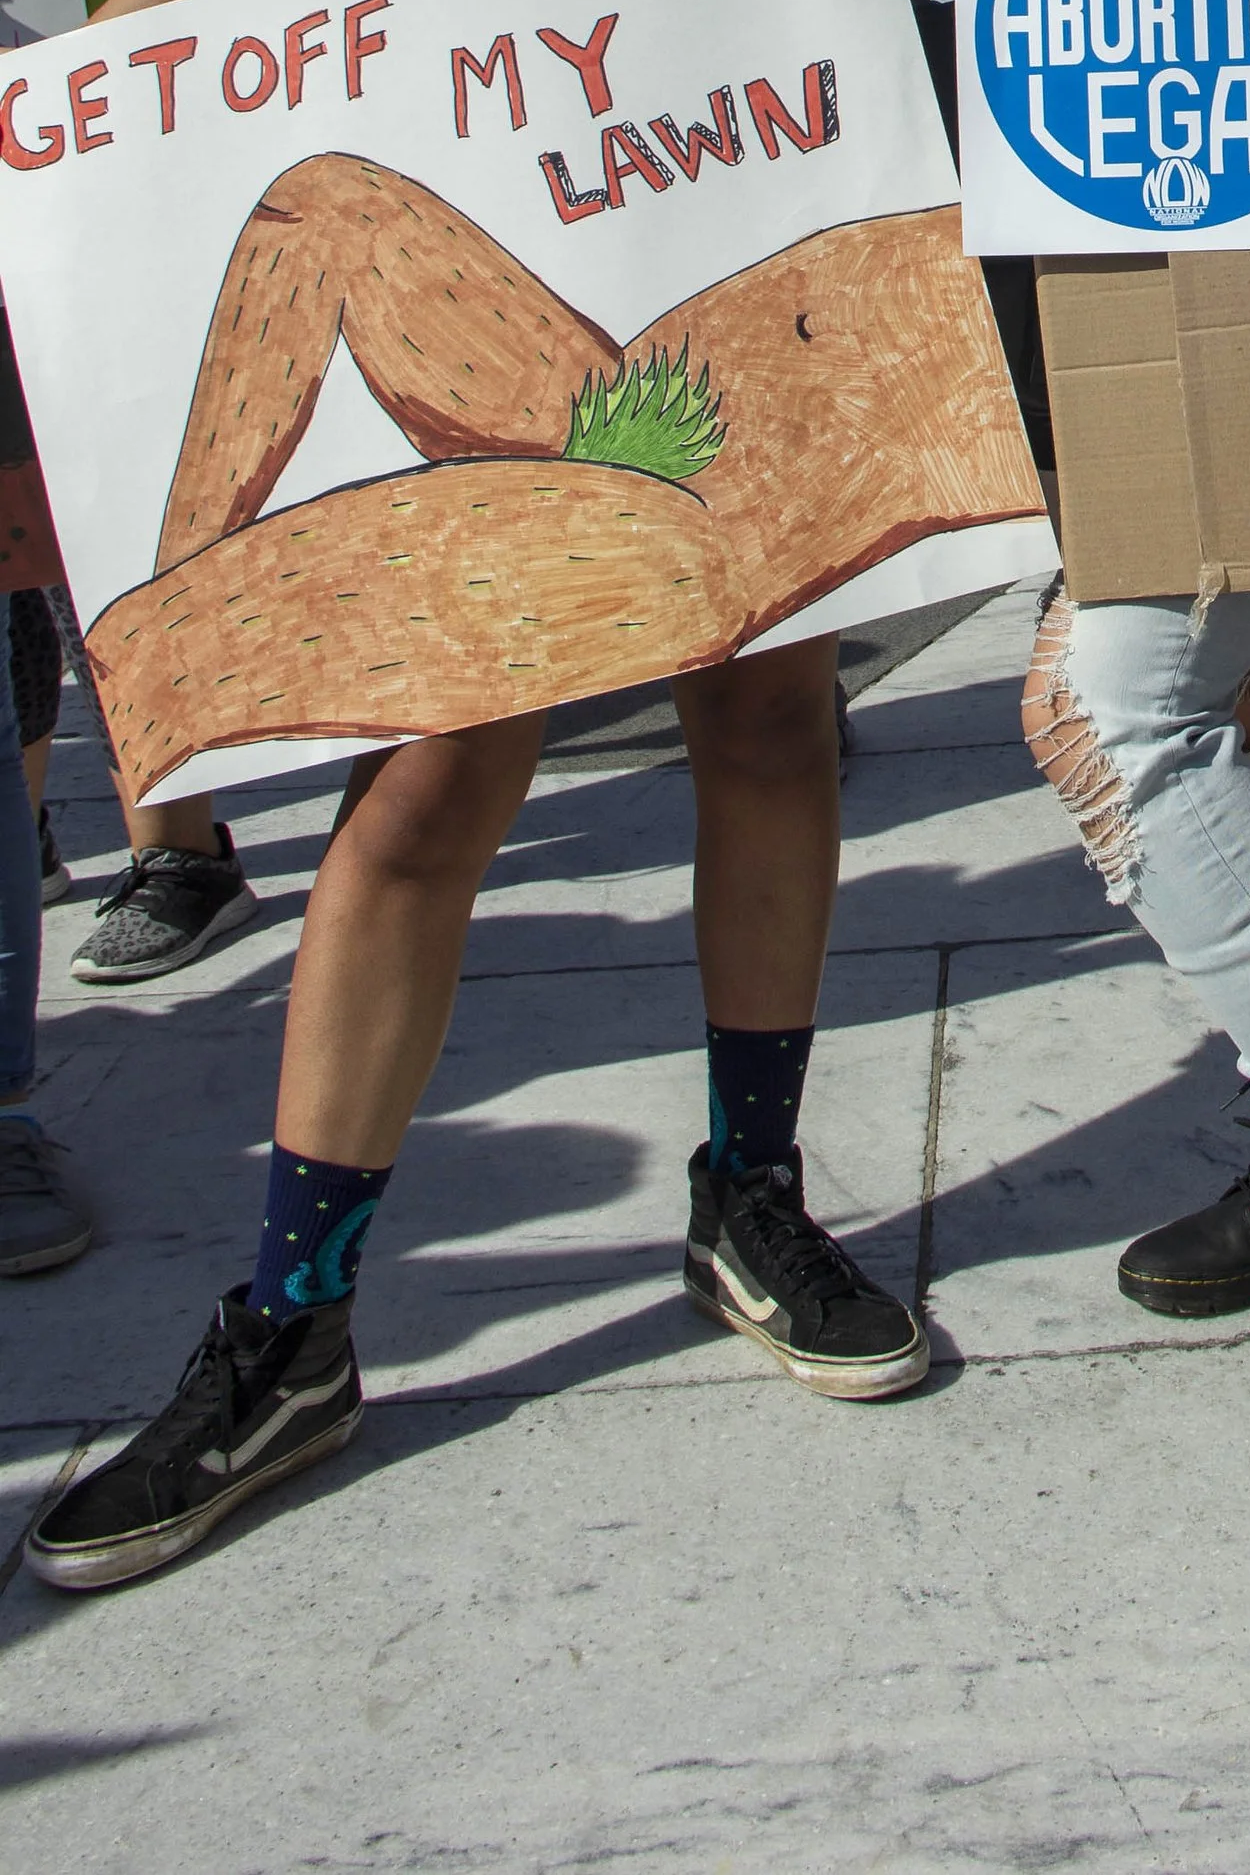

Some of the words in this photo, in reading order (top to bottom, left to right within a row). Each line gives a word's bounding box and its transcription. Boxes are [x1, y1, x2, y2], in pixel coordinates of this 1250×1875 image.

[0, 35, 198, 171] GET
[450, 12, 620, 139] MY
[538, 59, 840, 225] LAWN
[1142, 157, 1211, 208] NOW
